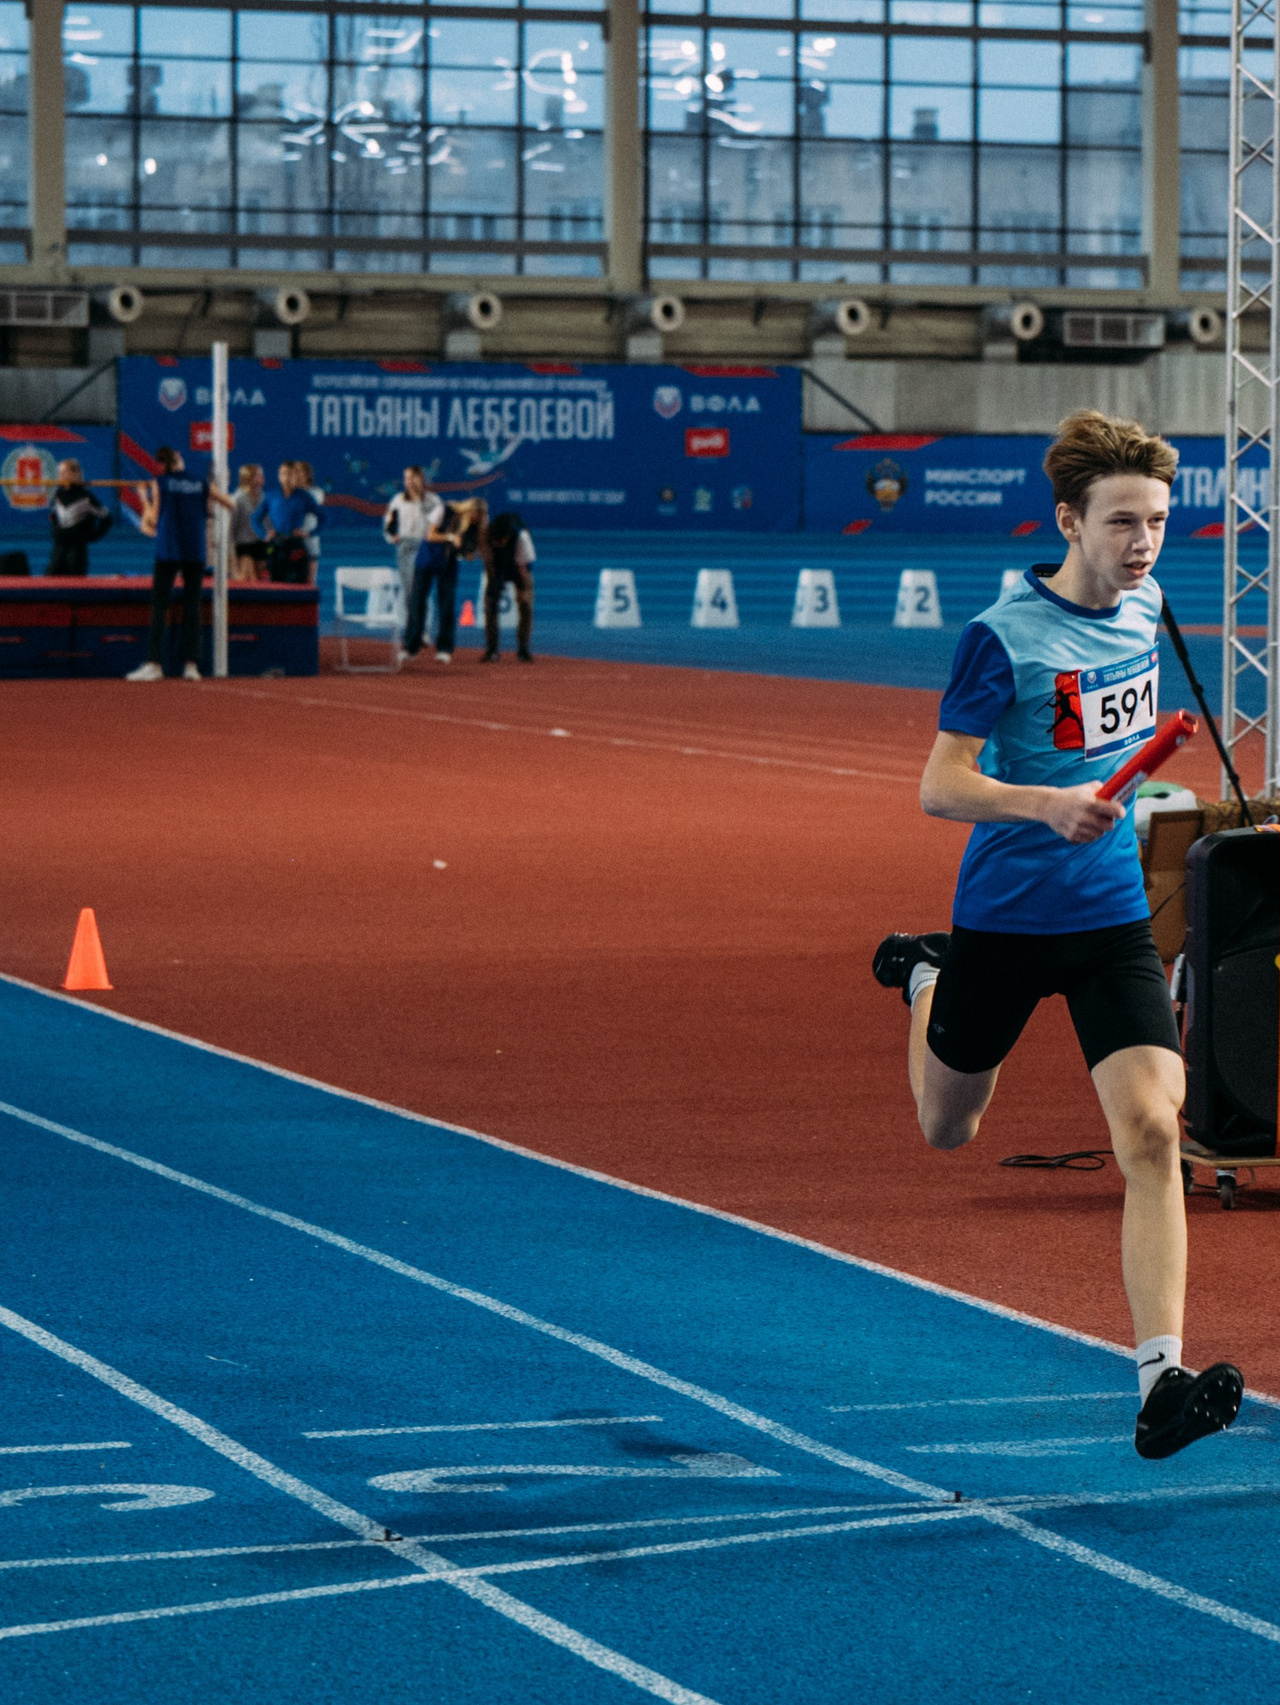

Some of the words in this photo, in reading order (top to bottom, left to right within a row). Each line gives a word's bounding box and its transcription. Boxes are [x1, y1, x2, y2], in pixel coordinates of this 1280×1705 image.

[195, 386, 266, 406] ВЛА
[306, 394, 440, 438] ТАТЬЯНЫ
[447, 389, 615, 442] ЛЕБЕДЕВОЙ
[925, 468, 1027, 485] МИНСПОРТ
[925, 490, 1003, 506] РОССИИ
[613, 584, 631, 613] 5
[710, 586, 728, 612] 4
[813, 585, 829, 613] 3
[915, 585, 930, 613] 2
[1100, 679, 1154, 735] 591
